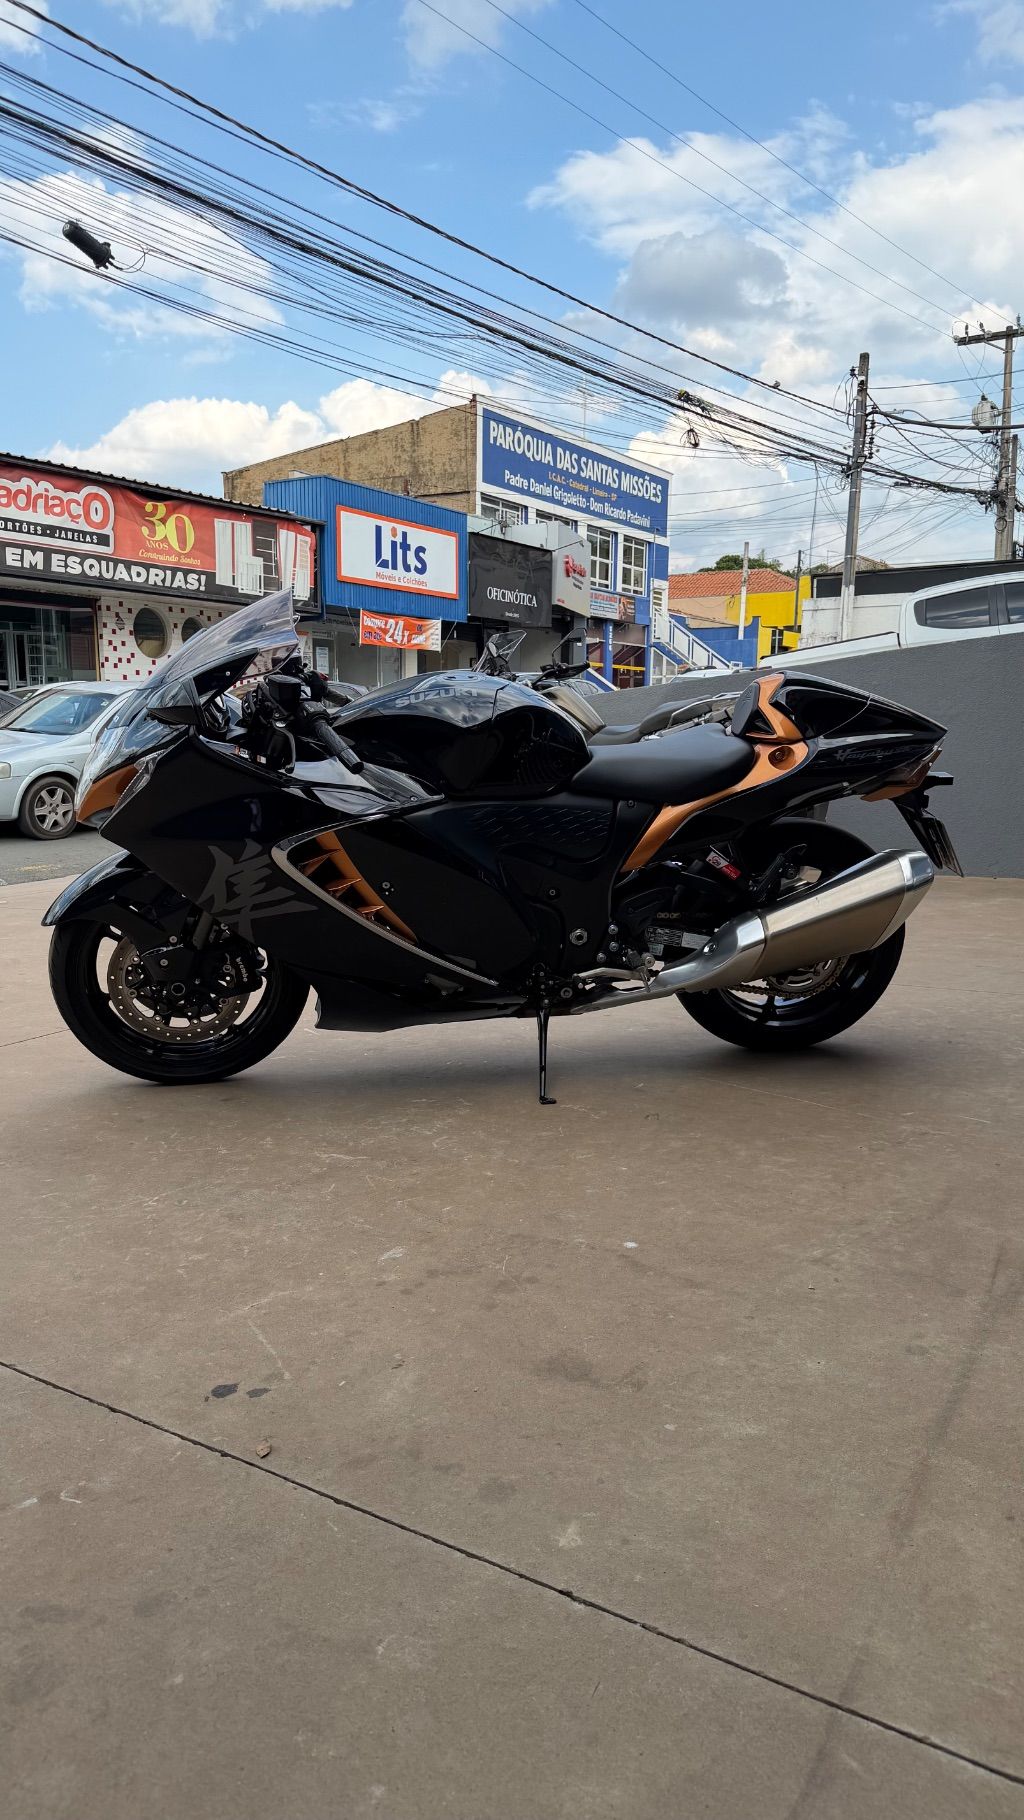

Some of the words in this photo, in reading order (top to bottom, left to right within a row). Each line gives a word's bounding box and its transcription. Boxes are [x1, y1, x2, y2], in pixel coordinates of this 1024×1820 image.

[489, 420, 554, 467] PARÓQUIA
[556, 447, 578, 475] DAS
[580, 456, 619, 489] SANTAS
[621, 471, 662, 504] MISSÕES
[504, 469, 529, 490] Padre
[529, 477, 553, 498] Daniel
[553, 486, 587, 508] Grigoletto
[589, 498, 604, 513] Dom
[604, 503, 627, 520] Ricardo
[54, 529, 98, 544] JANELAS
[141, 501, 195, 554] 30
[145, 540, 169, 550] ANOS
[375, 524, 428, 576] Lits
[5, 546, 44, 570] EM
[51, 553, 206, 591] ESQUADRIAS!
[375, 571, 396, 582] Móveis
[402, 576, 428, 587] Colchões
[487, 586, 538, 607] OFICINÓTICA
[395, 687, 478, 708] SUZUKI
